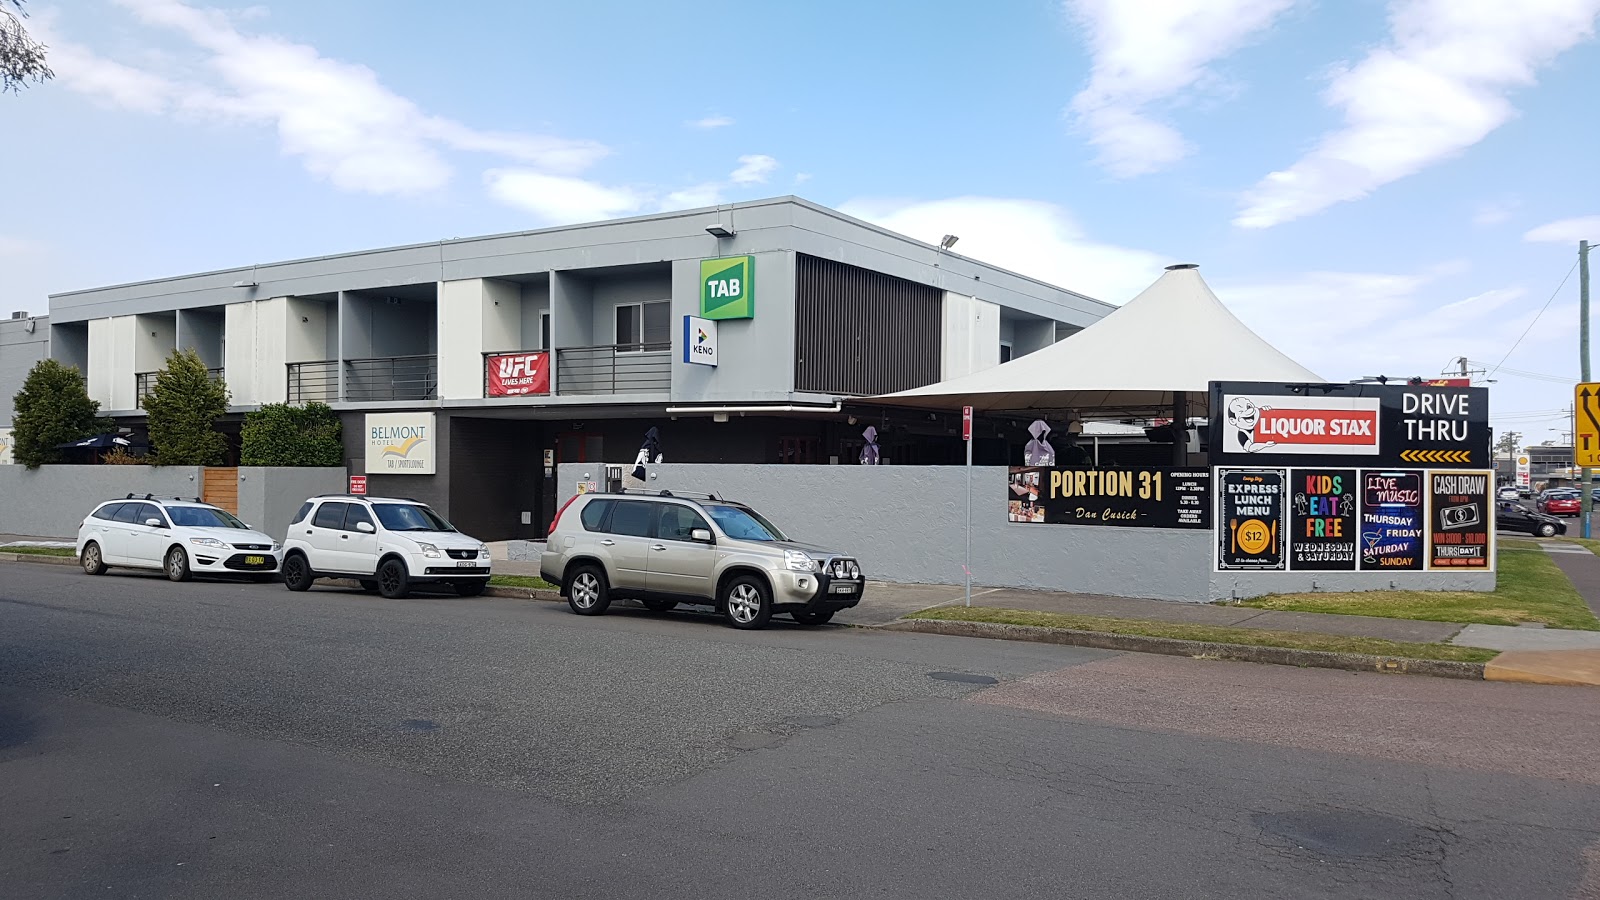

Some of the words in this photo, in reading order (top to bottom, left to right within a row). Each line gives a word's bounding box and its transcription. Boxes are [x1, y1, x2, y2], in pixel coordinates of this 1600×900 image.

[708, 278, 740, 298] TAB
[694, 344, 713, 356] KENO
[499, 355, 538, 378] UFC
[519, 376, 534, 384] HERE
[1402, 392, 1468, 415] DRIVE
[372, 426, 426, 439] BELMONT
[1260, 418, 1326, 438] LIQUOR
[1330, 418, 1371, 436] STAX
[1404, 420, 1468, 441] THRU
[0, 438, 8, 446] NT
[1050, 470, 1133, 499] PORTION
[1138, 471, 1162, 501] 31
[1228, 484, 1278, 494] EXPRESS
[1306, 475, 1342, 494] KIDS
[1367, 478, 1397, 489] LIVE
[1434, 476, 1456, 494] CASH
[1458, 476, 1485, 494] DRAW
[1234, 495, 1272, 505] LUNCH
[1377, 490, 1417, 502] MUSIC
[1236, 506, 1270, 516] MENU
[1310, 496, 1338, 516] EAT
[1076, 508, 1097, 518] Dan
[1102, 508, 1137, 520] Cusick
[1364, 514, 1412, 526] THURSDAY
[1306, 518, 1342, 537] FREE
[1386, 529, 1422, 537] FRIDAY
[1246, 530, 1262, 542] $12
[1433, 533, 1445, 543] WIN
[1293, 542, 1354, 552] WEDNESDAY
[1364, 542, 1409, 557] SATURDAY
[1298, 553, 1304, 561] &
[1305, 552, 1354, 561] SATURDAY
